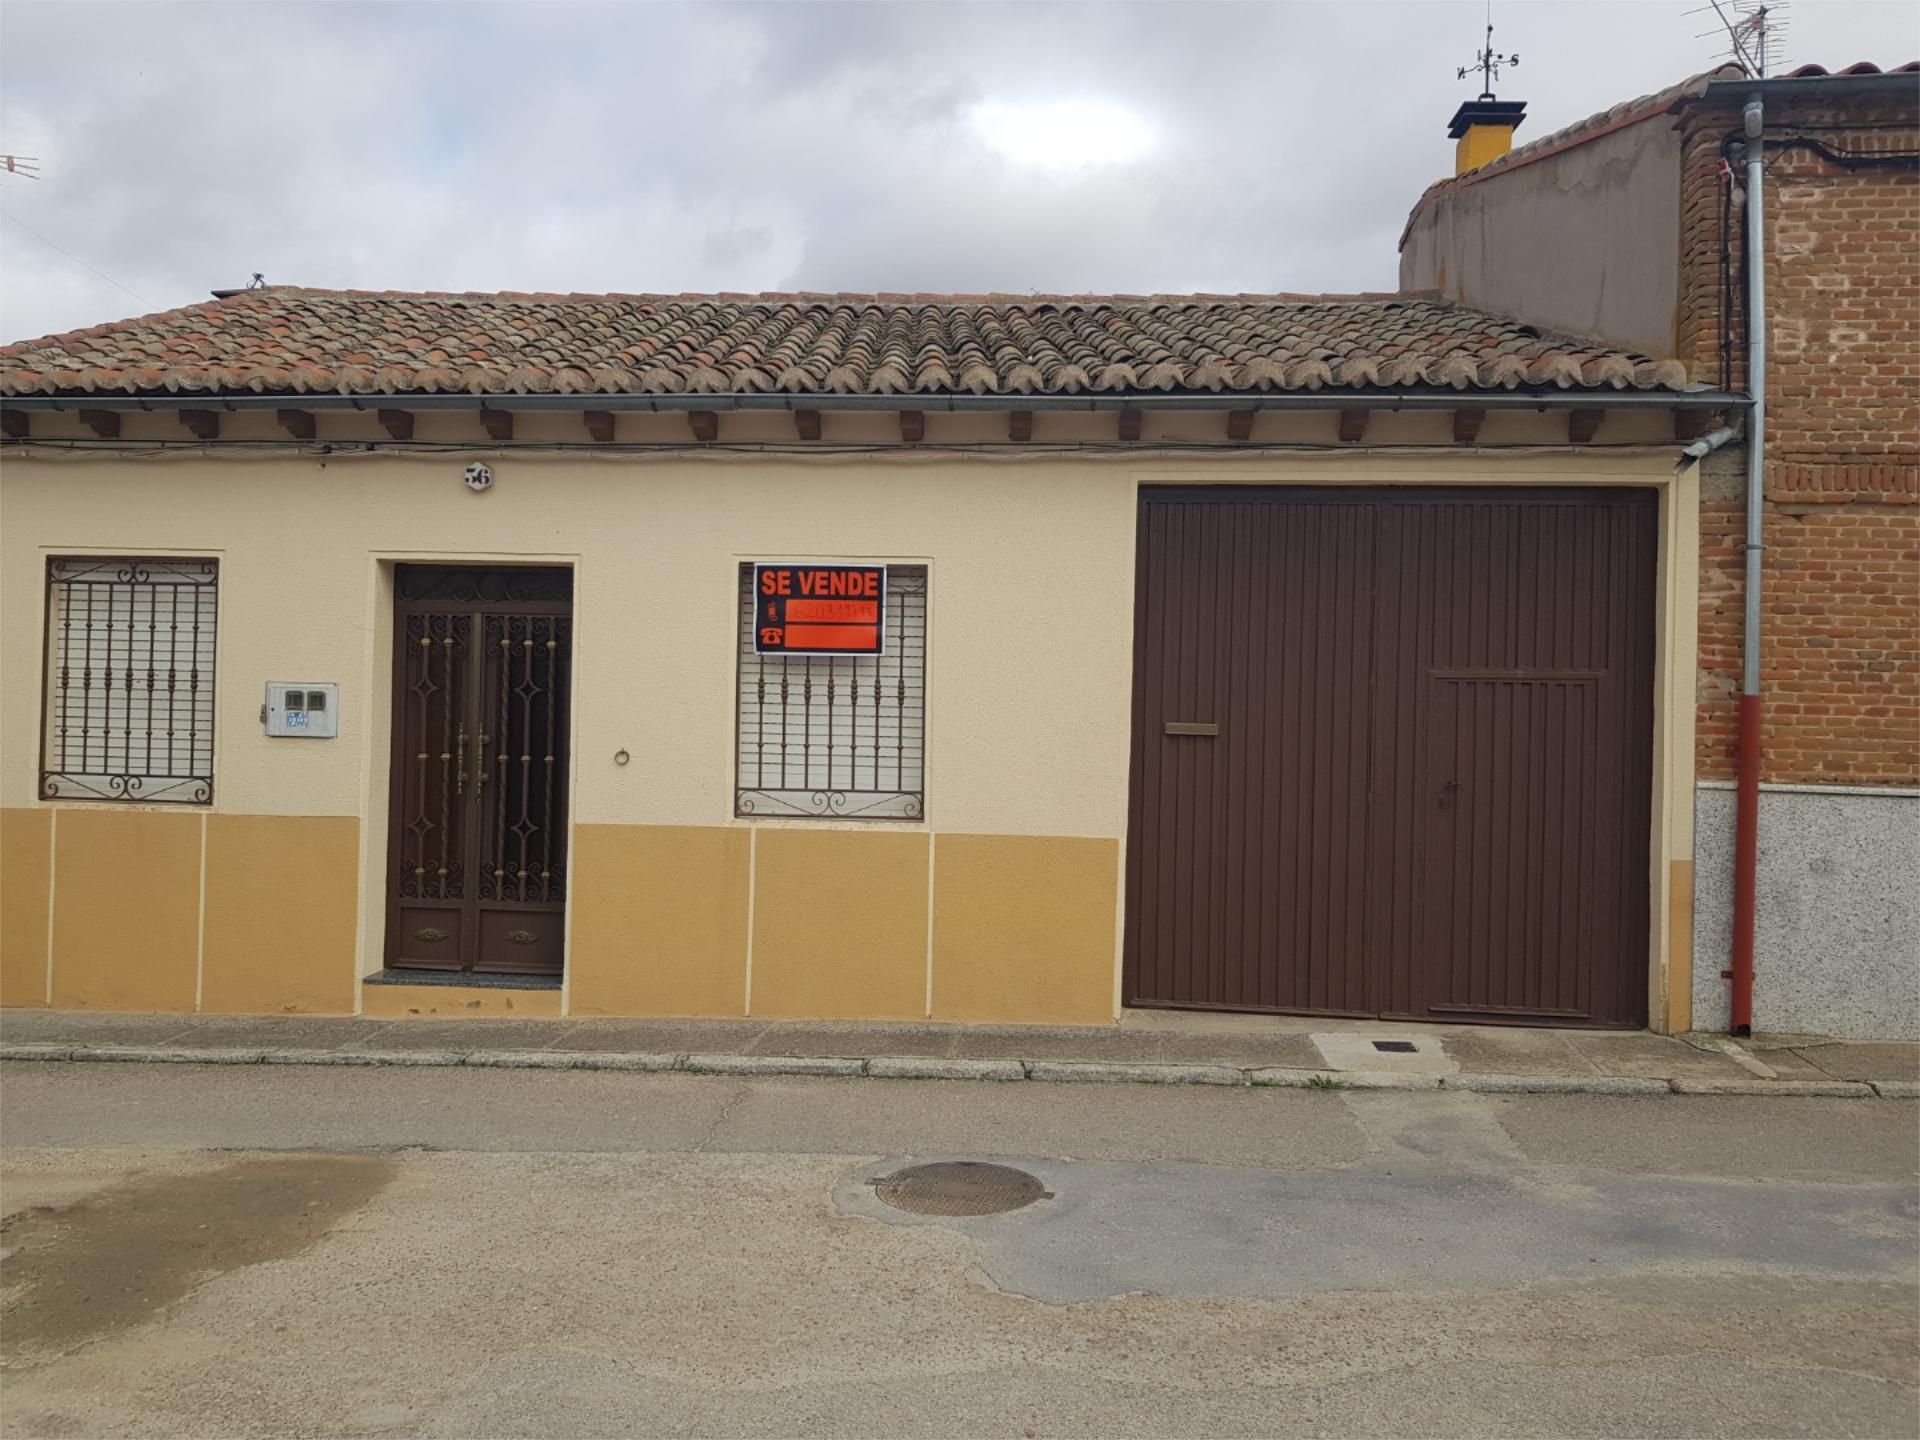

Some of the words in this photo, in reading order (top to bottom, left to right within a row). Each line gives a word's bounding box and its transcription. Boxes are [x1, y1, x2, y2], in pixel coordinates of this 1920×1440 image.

[465, 467, 490, 485] 56
[761, 570, 792, 596] SE
[798, 571, 879, 597] VENDE
